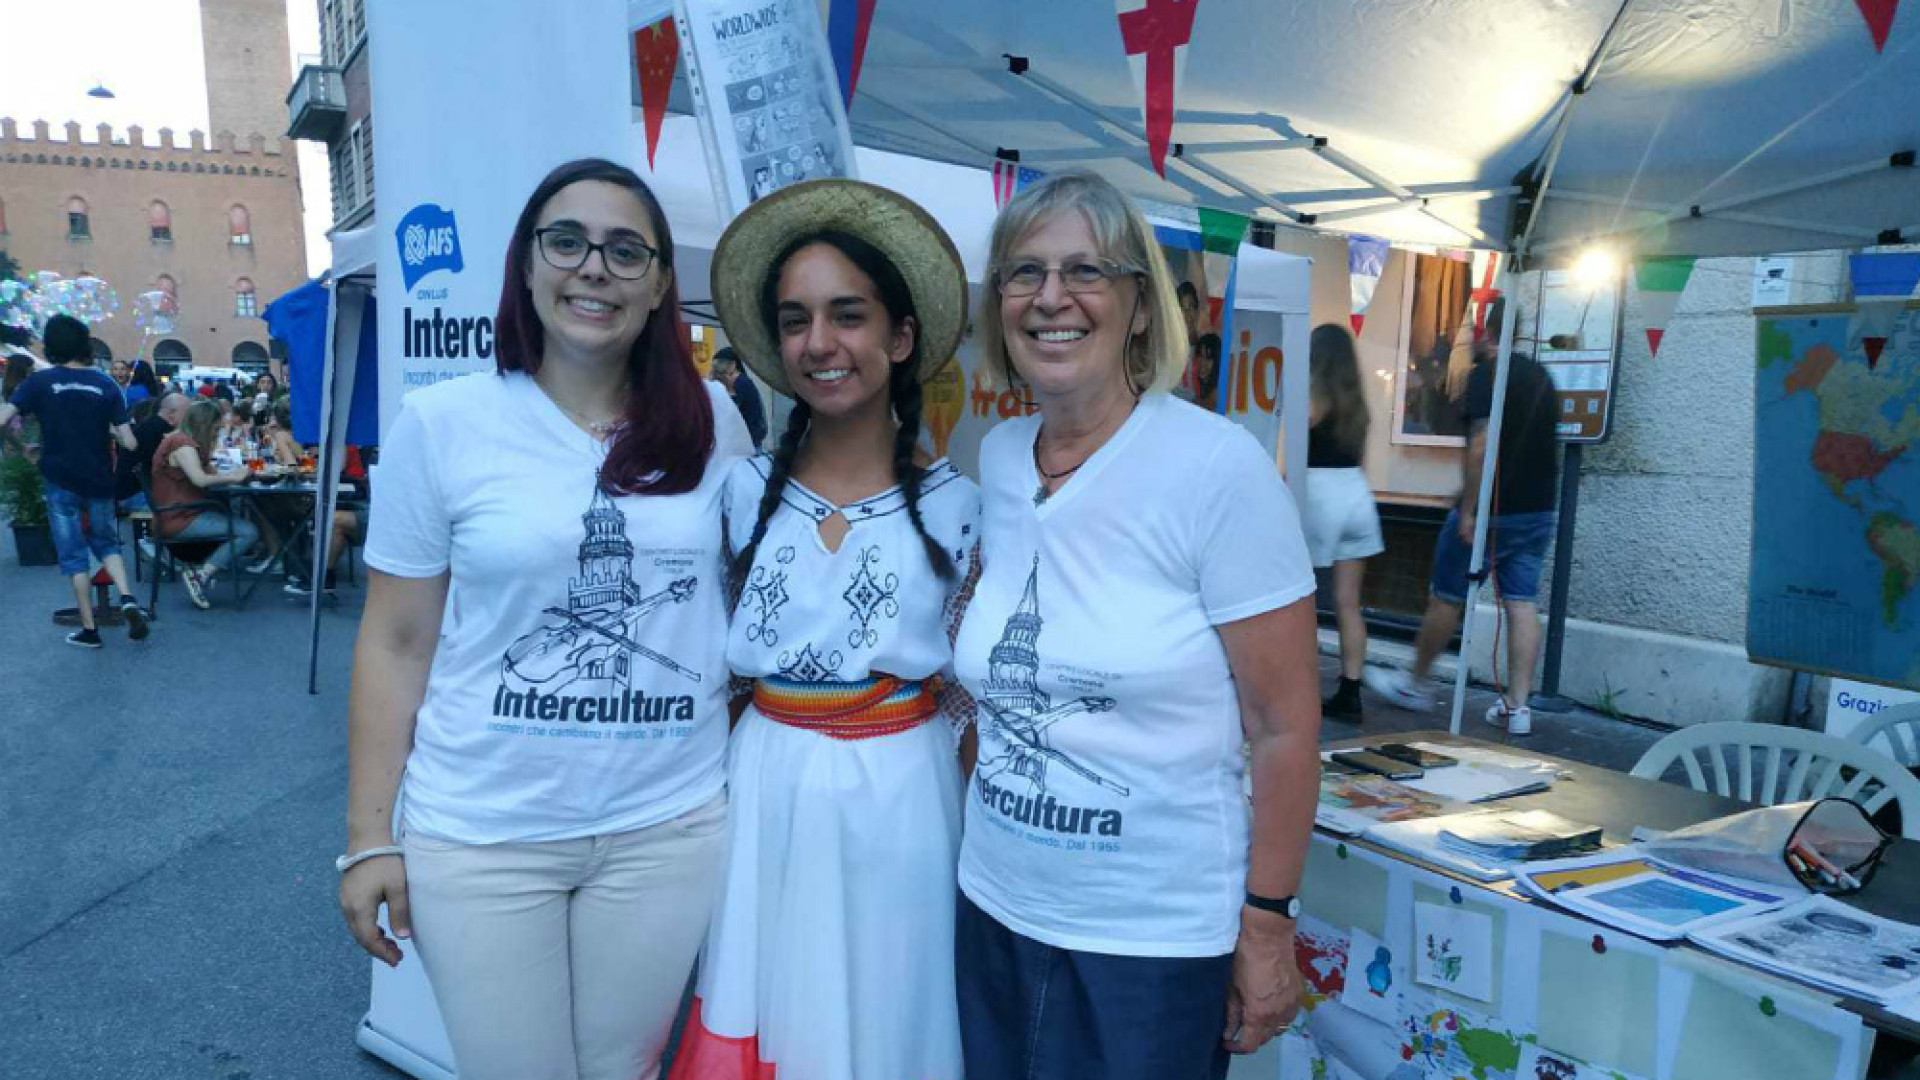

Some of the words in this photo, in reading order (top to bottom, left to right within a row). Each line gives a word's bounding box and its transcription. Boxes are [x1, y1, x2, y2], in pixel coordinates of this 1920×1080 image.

[712, 4, 779, 40] WORLDWIDE
[428, 227, 454, 256] AFS
[404, 307, 494, 359] Interc
[493, 684, 695, 723] Intercultura
[1837, 691, 1889, 714] Grazi
